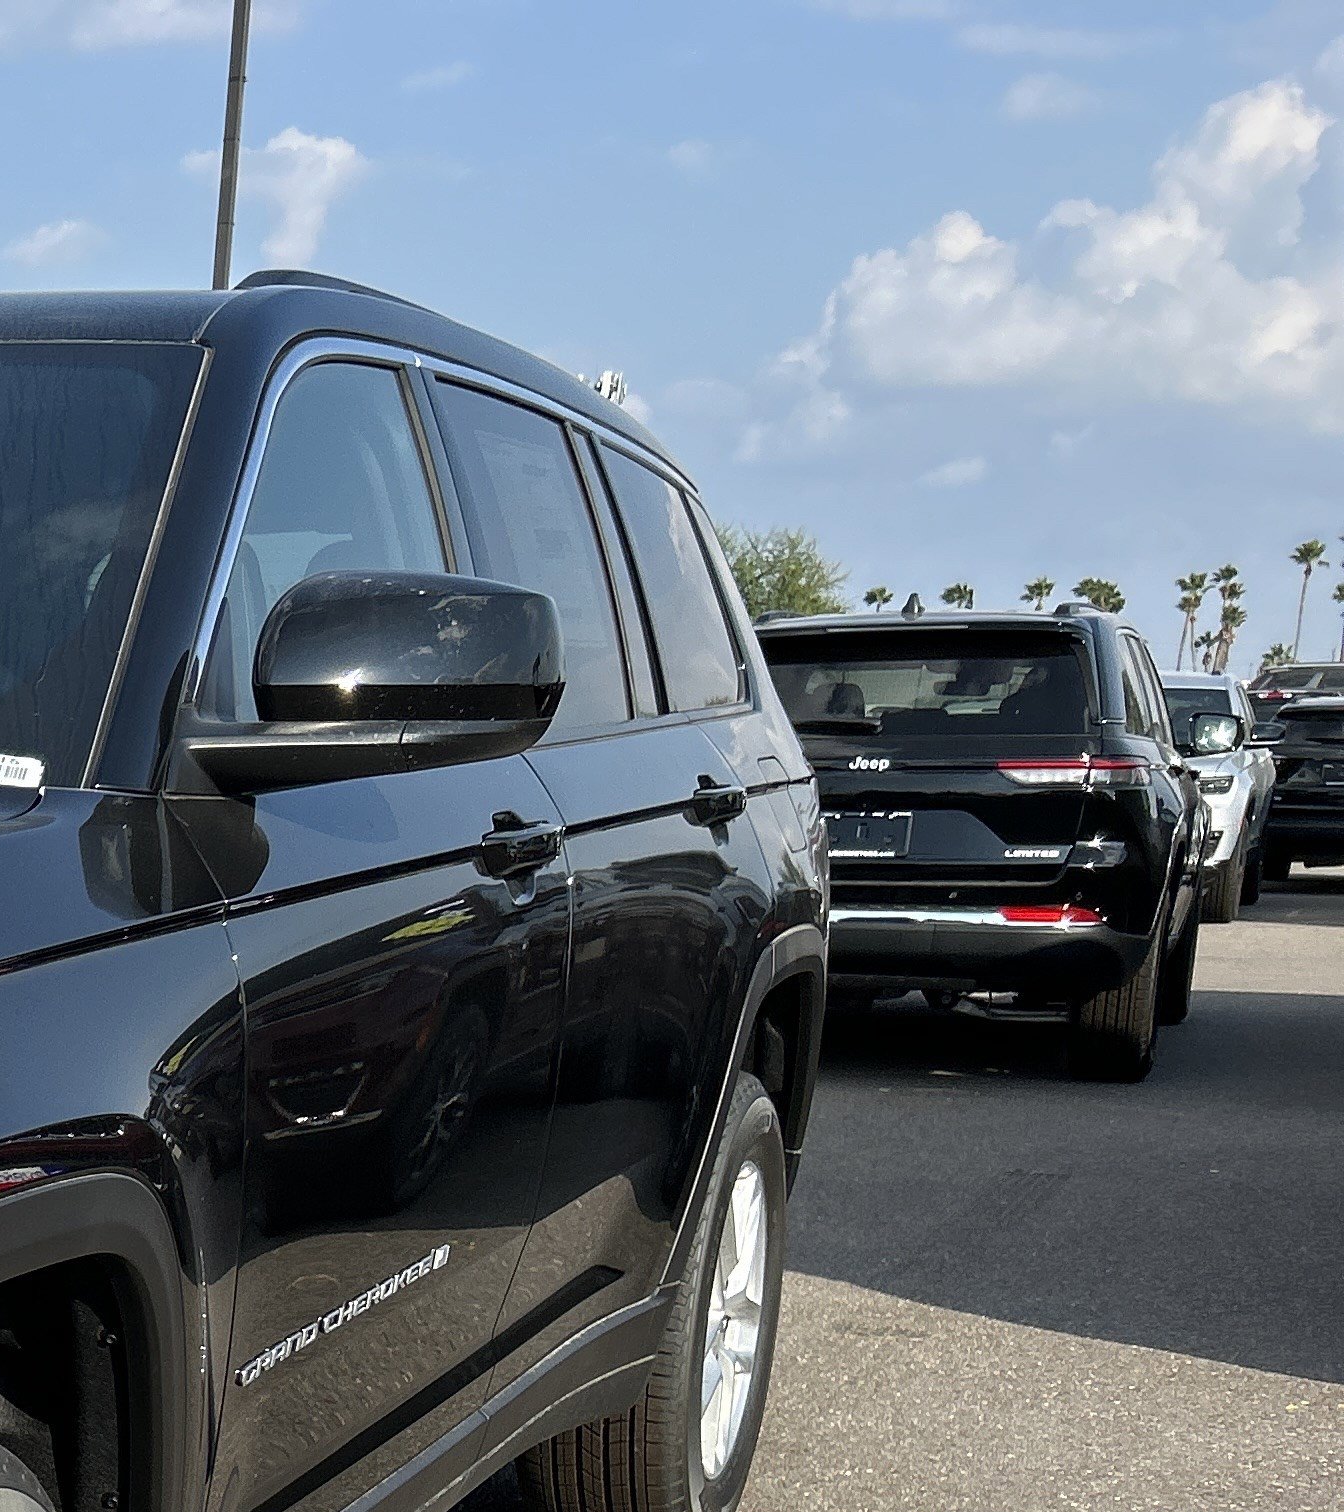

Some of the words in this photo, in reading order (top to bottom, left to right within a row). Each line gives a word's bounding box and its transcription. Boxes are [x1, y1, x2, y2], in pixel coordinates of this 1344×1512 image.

[848, 756, 890, 772] Jeep
[235, 1316, 323, 1387] GRAND
[321, 1248, 435, 1334] CHEROKEE
